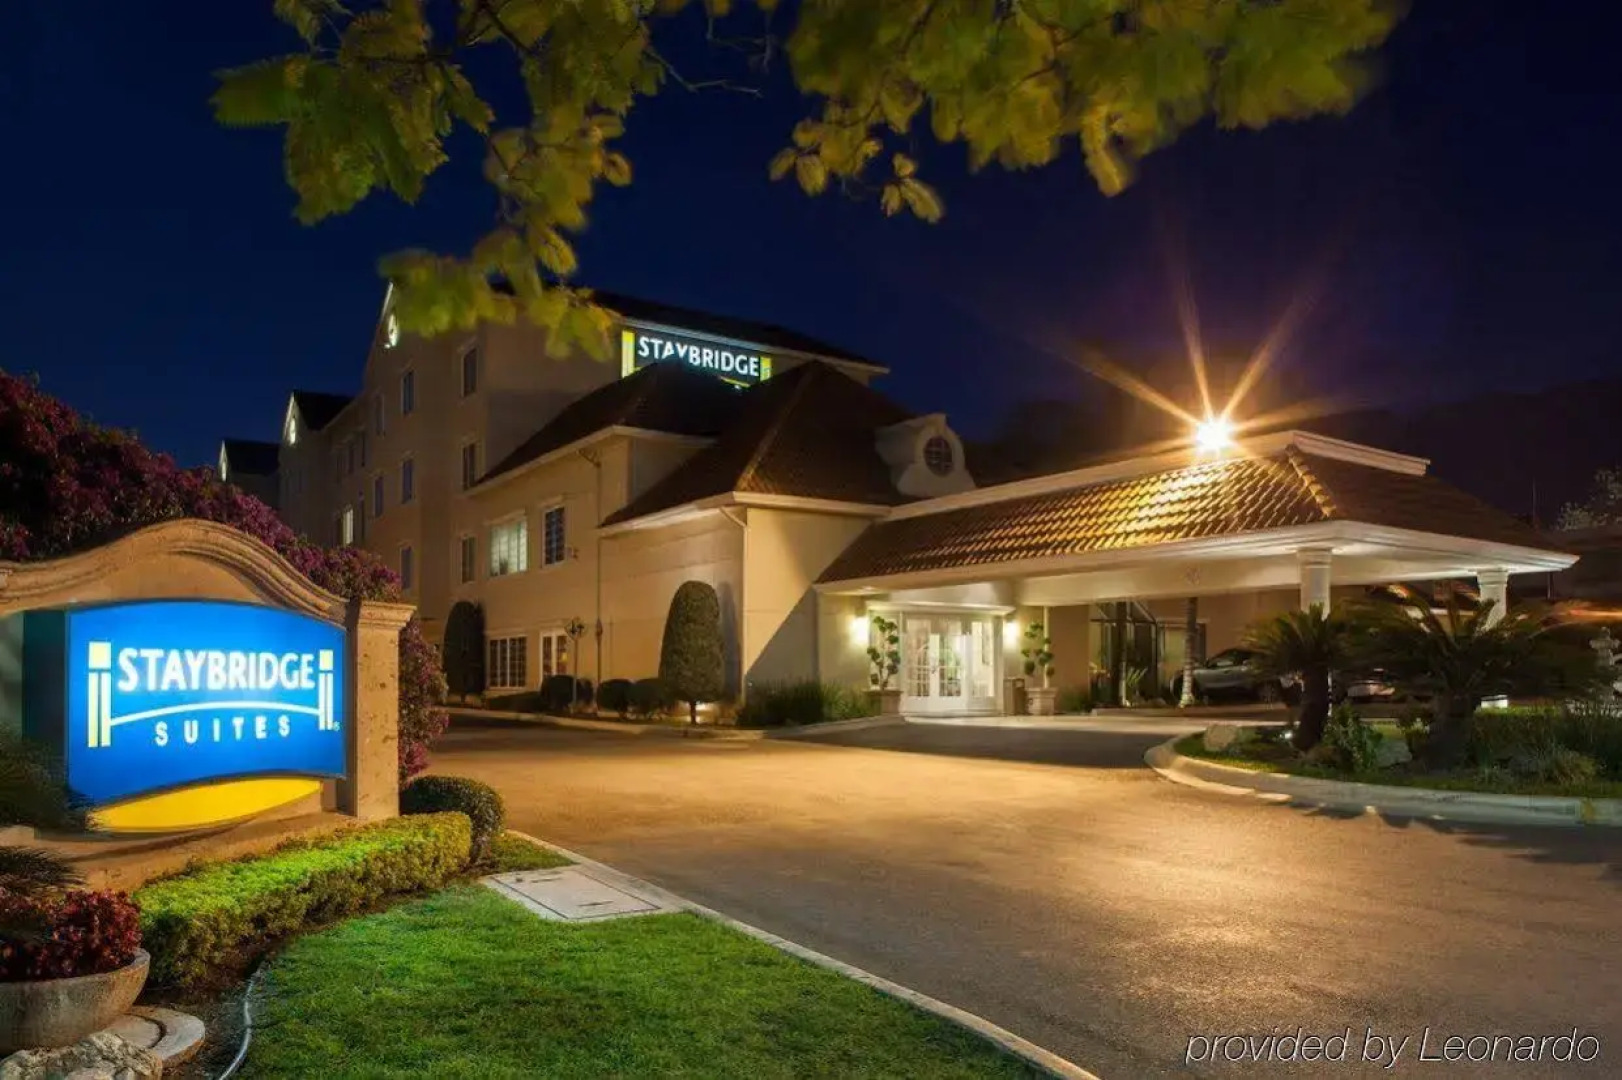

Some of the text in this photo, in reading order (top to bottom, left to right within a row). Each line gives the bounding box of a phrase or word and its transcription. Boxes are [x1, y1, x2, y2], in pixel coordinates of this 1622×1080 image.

[637, 336, 761, 377] STAYBRIDGE
[117, 648, 316, 692] STAYBRIDGE
[154, 715, 291, 747] SUITES
